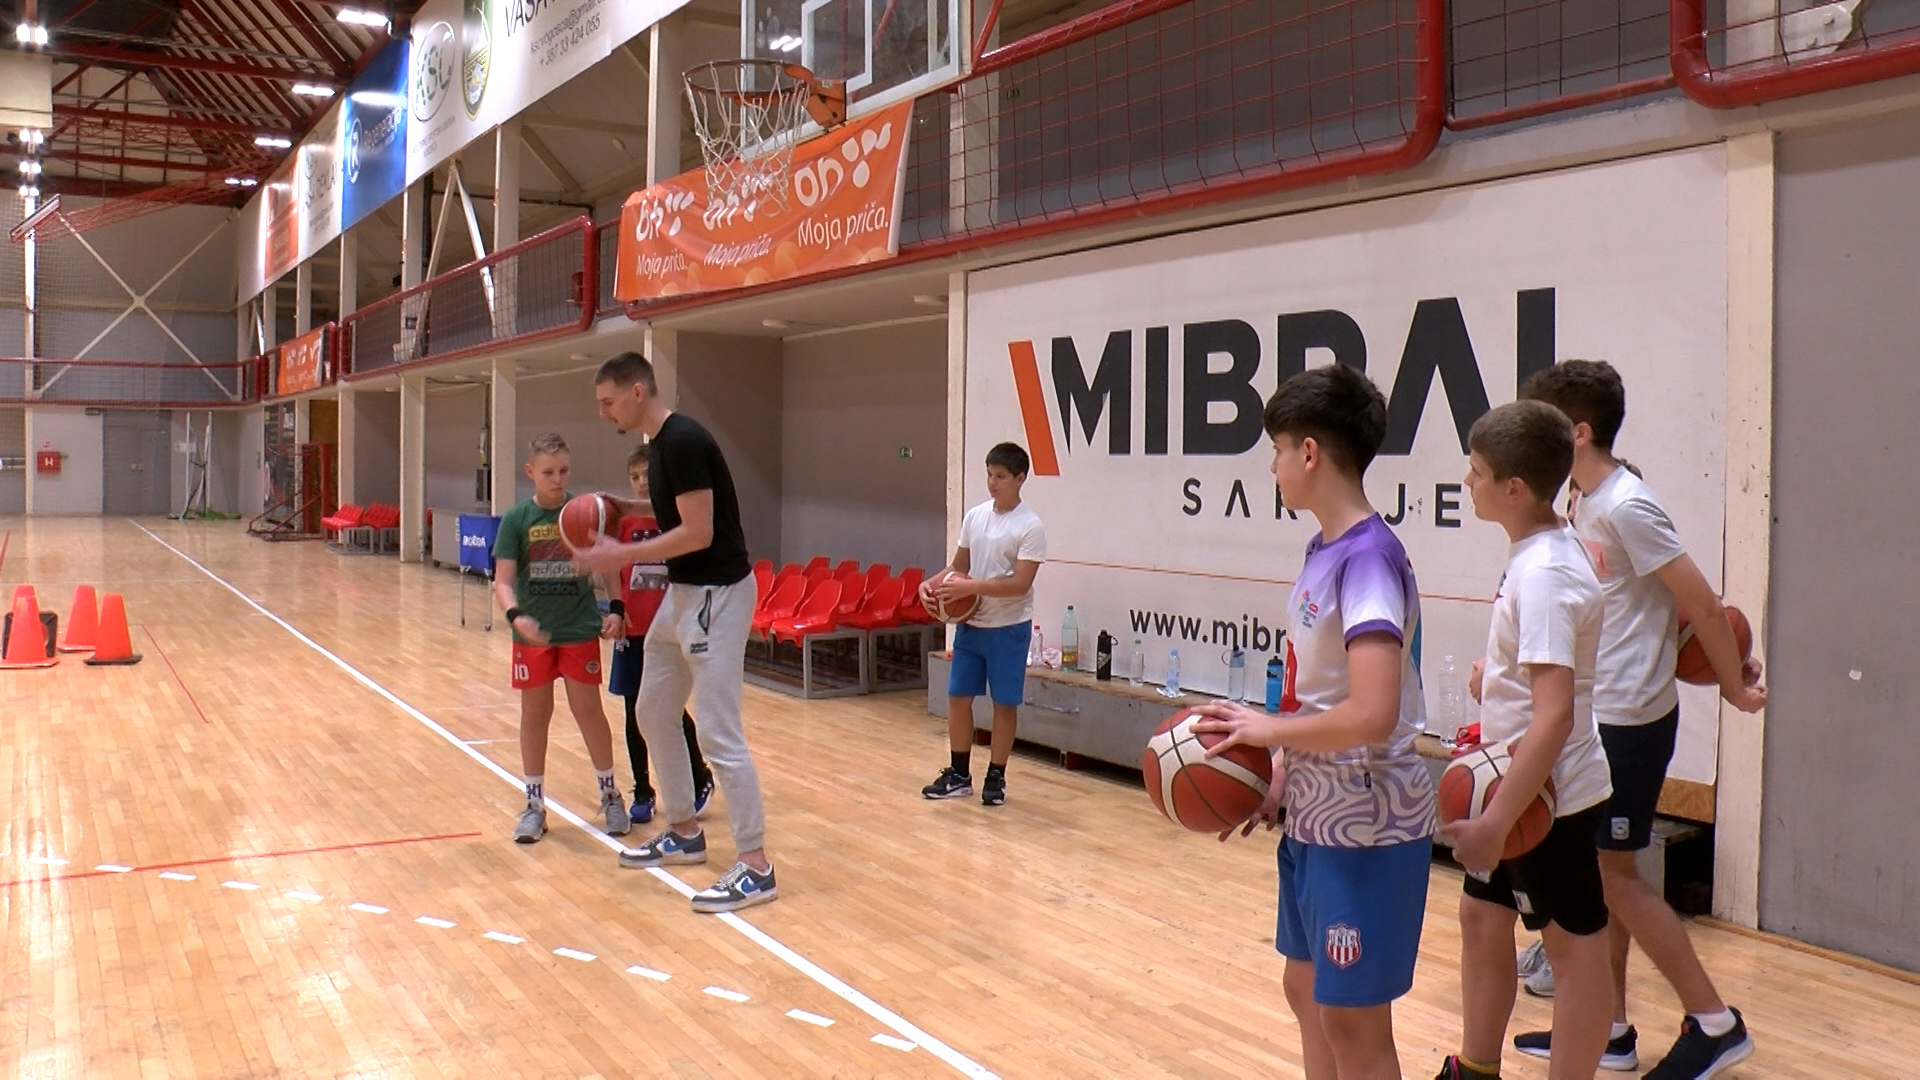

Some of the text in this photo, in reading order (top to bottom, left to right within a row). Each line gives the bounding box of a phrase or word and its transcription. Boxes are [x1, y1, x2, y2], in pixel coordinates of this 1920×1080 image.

[798, 201, 889, 250] Moja priča.
[636, 252, 664, 280] Moja
[704, 242, 738, 270] Moja
[1130, 609, 1287, 653] www.mibr
[514, 663, 530, 681] 10
